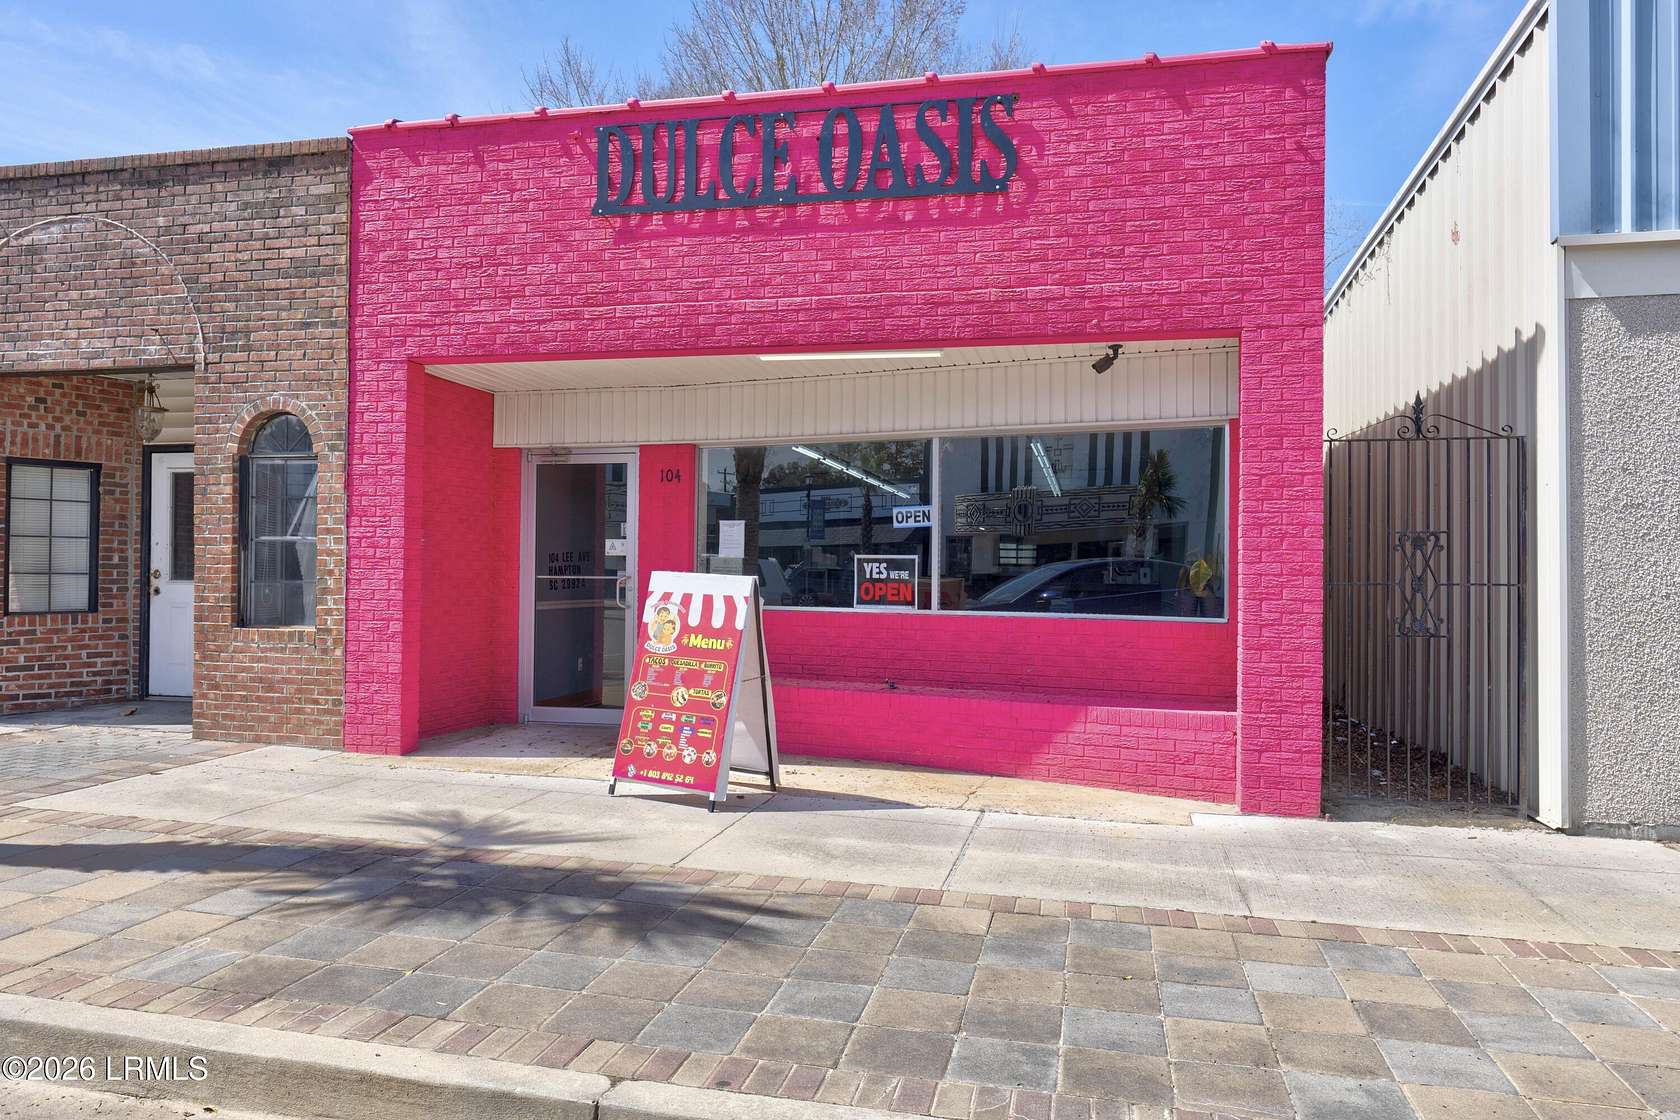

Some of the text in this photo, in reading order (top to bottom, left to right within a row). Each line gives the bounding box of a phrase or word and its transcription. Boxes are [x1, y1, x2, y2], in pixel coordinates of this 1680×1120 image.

[595, 94, 1019, 213] DULCE OASIS
[659, 468, 682, 484] 104
[895, 508, 931, 525] OPEN
[548, 552, 559, 563] 104
[562, 552, 574, 562] LEE
[548, 564, 582, 576] HAMPTON
[863, 562, 910, 580] YES WE'RE
[860, 582, 913, 602] OPEN
[646, 642, 676, 653] DULCE OASIS
[688, 633, 726, 650] Menu
[647, 656, 667, 665] TACOS
[703, 662, 723, 670] BURRITO
